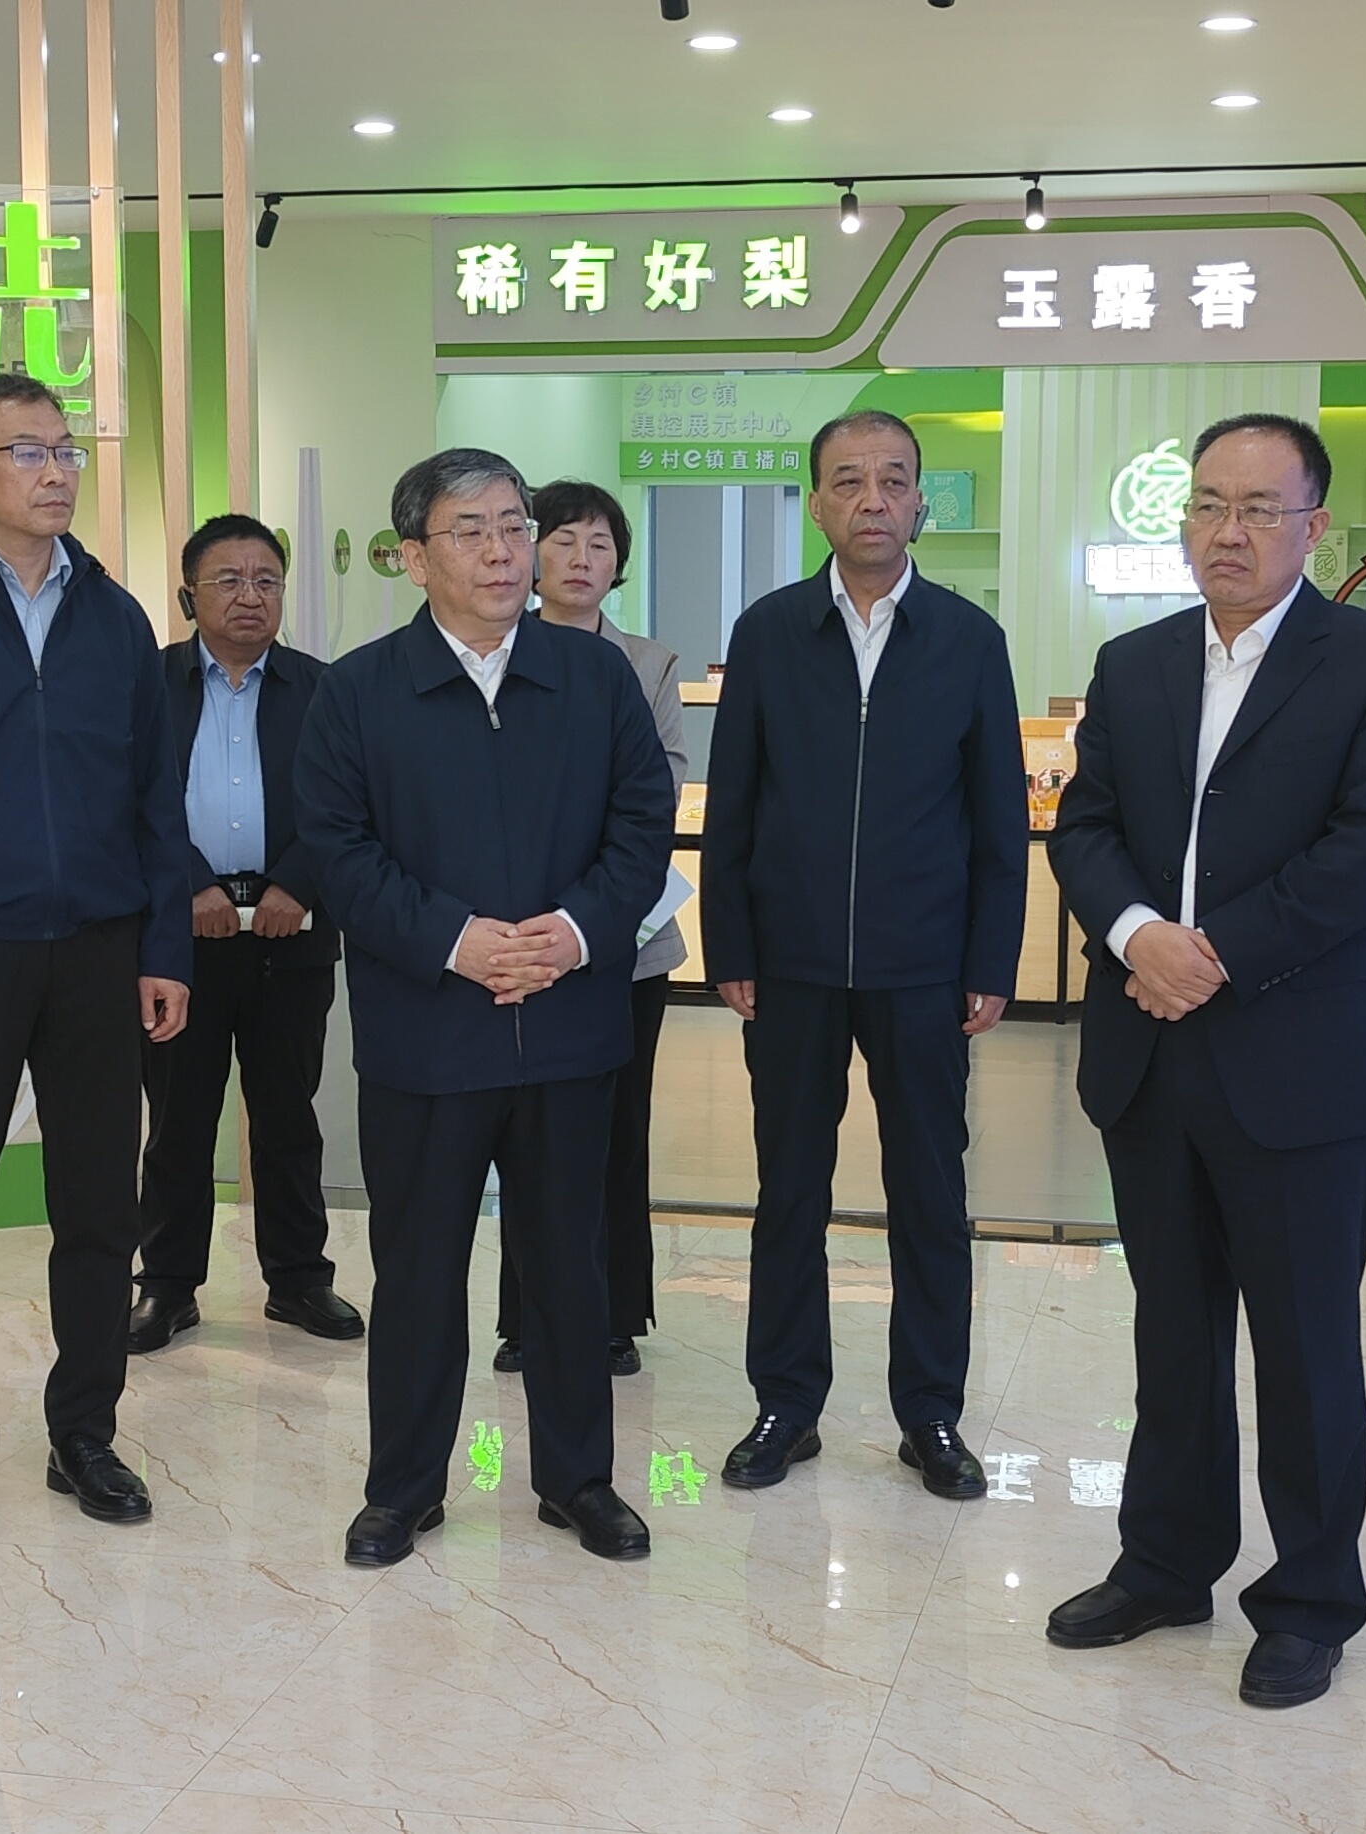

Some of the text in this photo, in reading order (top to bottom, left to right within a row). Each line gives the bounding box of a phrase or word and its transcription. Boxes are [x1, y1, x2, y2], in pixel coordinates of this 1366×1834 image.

[454, 234, 810, 316] 稀有好梨
[998, 261, 1258, 330] 玉露香
[633, 379, 737, 407] 乡村e镇
[631, 411, 792, 438] 集控展示中心
[637, 448, 801, 470] 乡村e镇直播间
